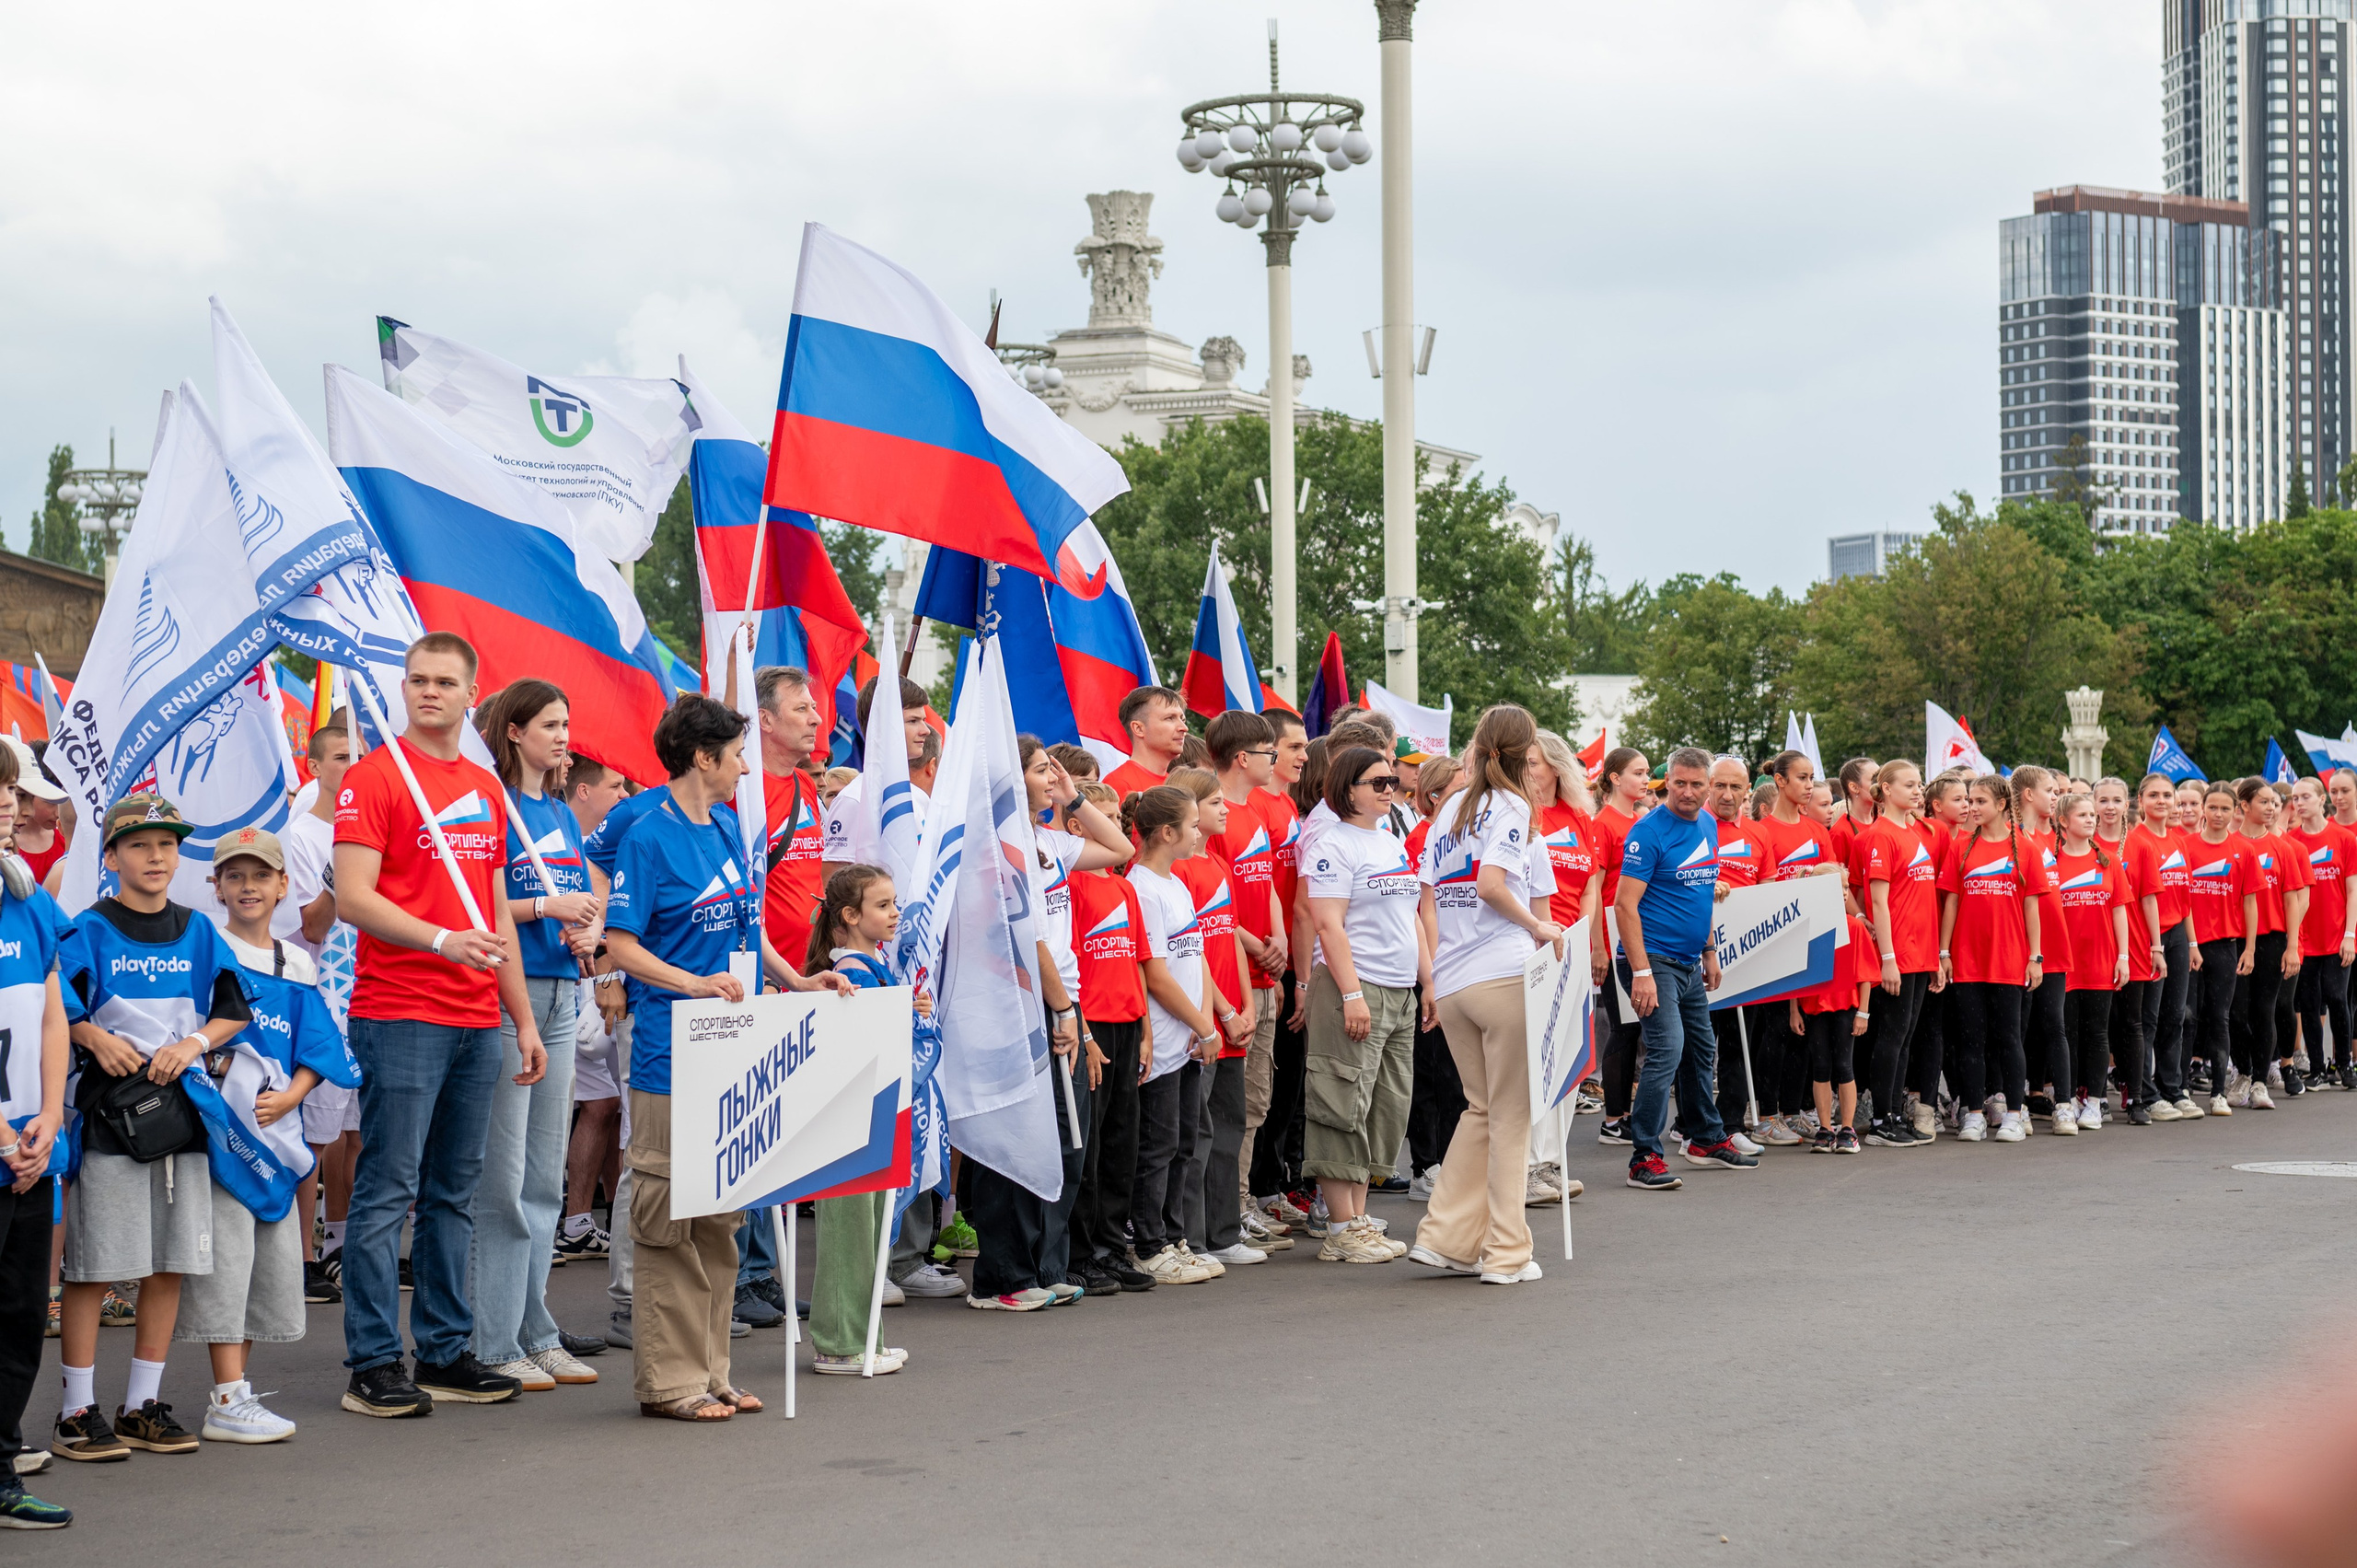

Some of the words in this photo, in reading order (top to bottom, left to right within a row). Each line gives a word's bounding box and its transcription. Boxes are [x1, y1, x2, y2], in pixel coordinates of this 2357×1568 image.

[493, 454, 555, 470] Московский
[557, 462, 632, 488] государственный
[539, 476, 588, 485] технологий
[598, 489, 624, 514] (ПКУ)
[781, 851, 824, 861] ШЕСТВИ
[1550, 860, 1588, 872] ЕСТВИЕ
[2061, 890, 2110, 901] ПОРТИВНОЕ
[1718, 943, 1738, 970] НА
[1739, 898, 1801, 956] КОНЬКАХ
[690, 1030, 738, 1041] ШЕСТВИЕ
[715, 1007, 816, 1146] ЛЫЖНЫЕ
[716, 1094, 781, 1201] ГОНКИ
